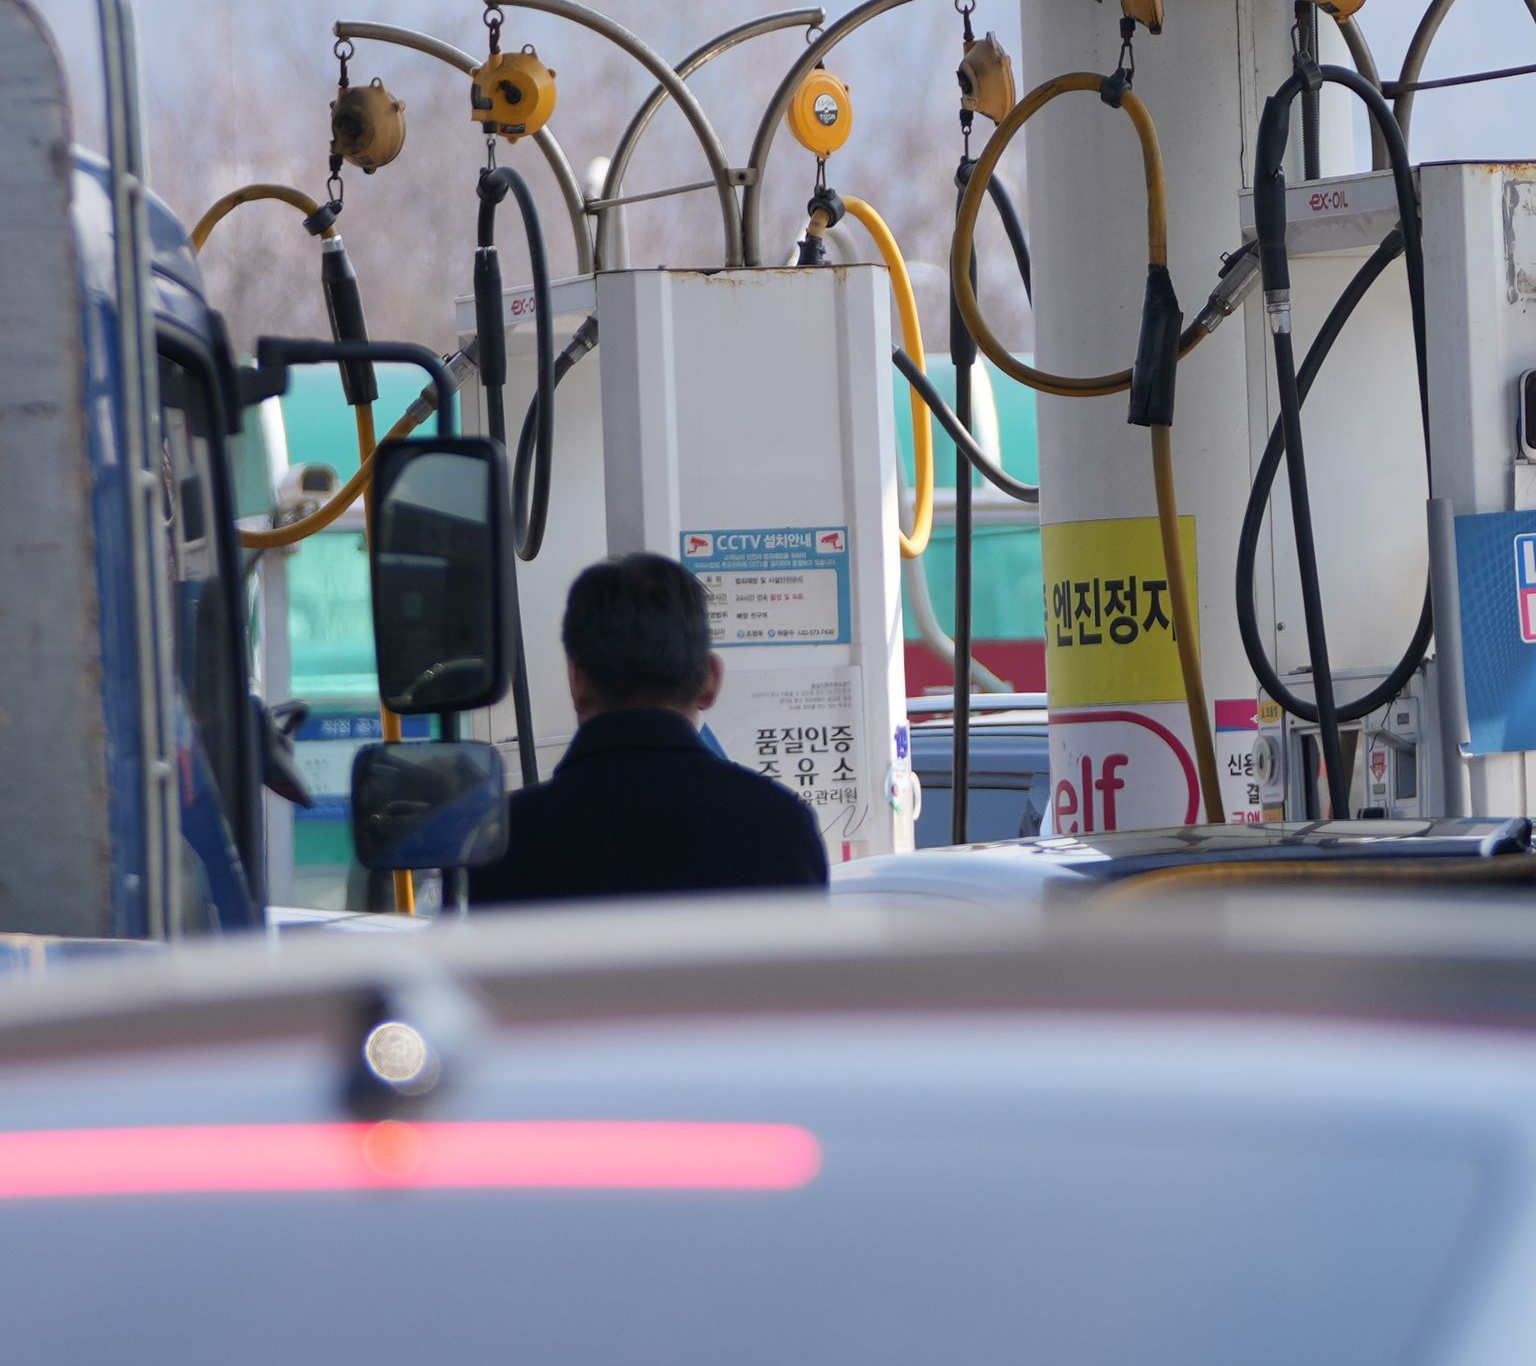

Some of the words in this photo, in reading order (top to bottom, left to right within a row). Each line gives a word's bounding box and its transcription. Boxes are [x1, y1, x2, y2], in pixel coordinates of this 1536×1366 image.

[716, 534, 761, 550] CCTV
[763, 533, 811, 549] 설치안내
[755, 725, 854, 756] 품질인증
